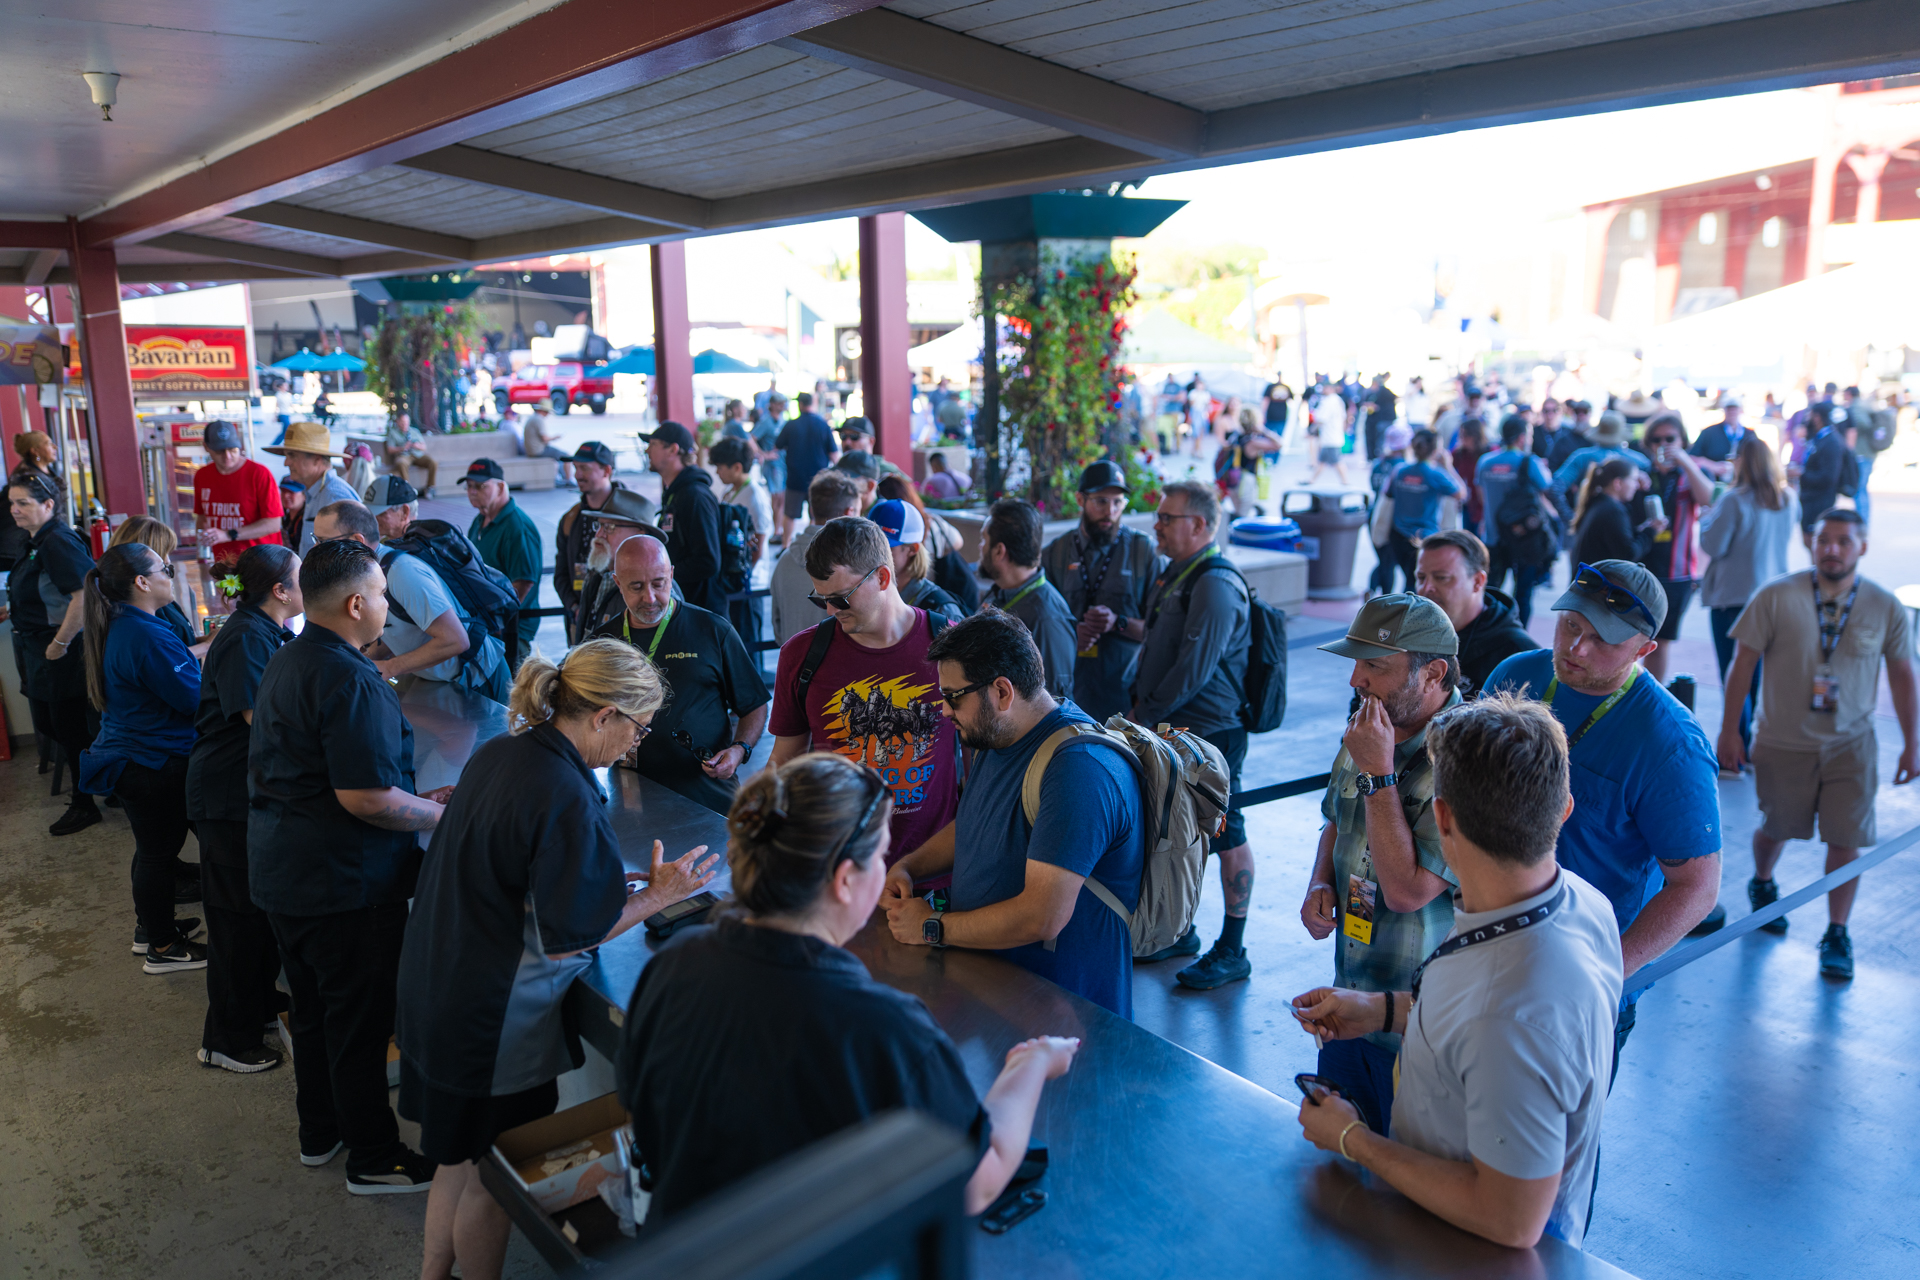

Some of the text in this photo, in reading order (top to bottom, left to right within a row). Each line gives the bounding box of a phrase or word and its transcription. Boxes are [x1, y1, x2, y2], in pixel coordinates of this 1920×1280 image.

[127, 345, 232, 366] Bavarian
[165, 381, 191, 391] SOFT
[193, 381, 244, 390] PRETZELS
[211, 503, 241, 516] TRUCK
[905, 764, 935, 784] OF
[1459, 906, 1549, 946] LEXUS
